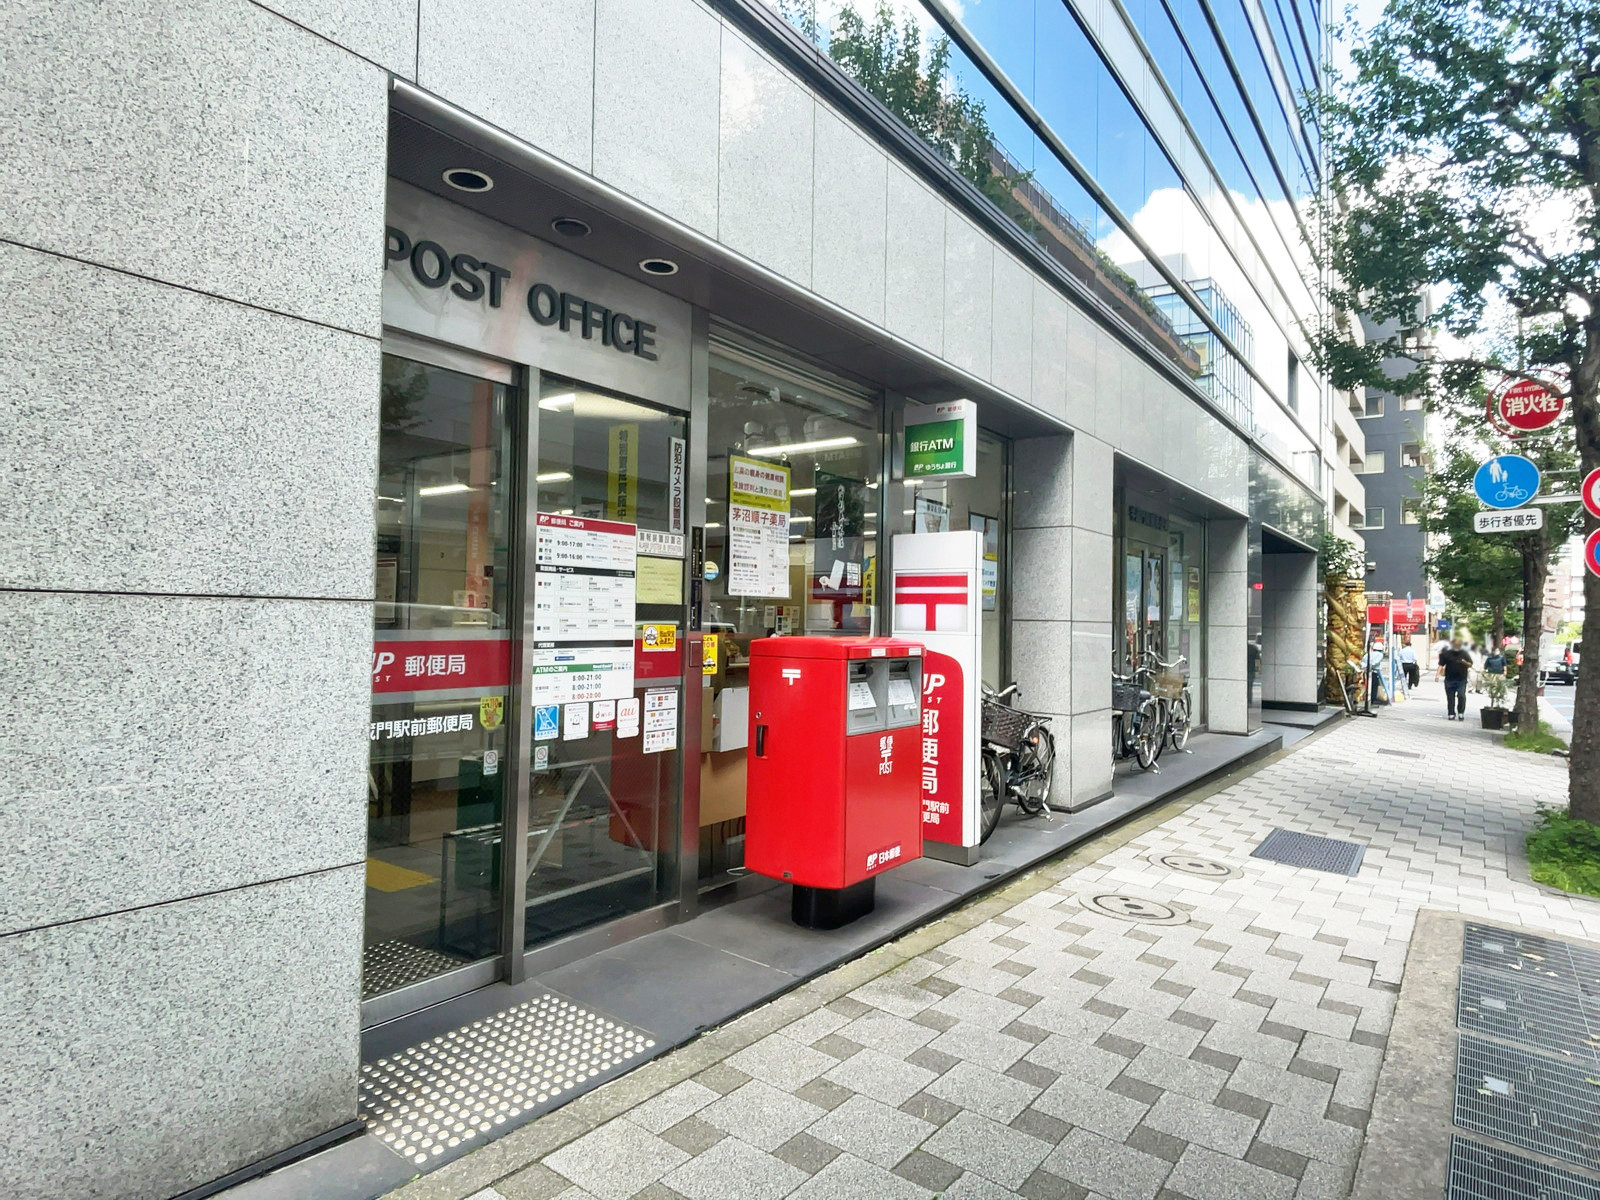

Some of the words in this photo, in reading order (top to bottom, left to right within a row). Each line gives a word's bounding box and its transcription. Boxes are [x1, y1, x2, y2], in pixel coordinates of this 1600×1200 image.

[385, 225, 511, 308] POST
[527, 283, 659, 362] OFFICE
[1505, 393, 1559, 418] 消火栓
[910, 437, 954, 452] 銀行ATM
[925, 461, 957, 470] ゆうちょ銀行
[569, 520, 584, 528] ご案内
[732, 507, 786, 528] 茅沼順子薬局
[1478, 514, 1537, 529] 歩行者優先
[557, 540, 583, 548] 9:00-17:00
[556, 552, 583, 560] 9:00-16:00
[404, 654, 466, 677] 郵便局
[572, 674, 602, 682] 8:00-21:00
[572, 683, 602, 691] 8:00-21:00
[572, 692, 602, 700] 8:00-20:00
[620, 707, 636, 717] au
[880, 736, 893, 750] 郵便
[879, 761, 892, 775] POST
[878, 846, 901, 864] 日本郵便
